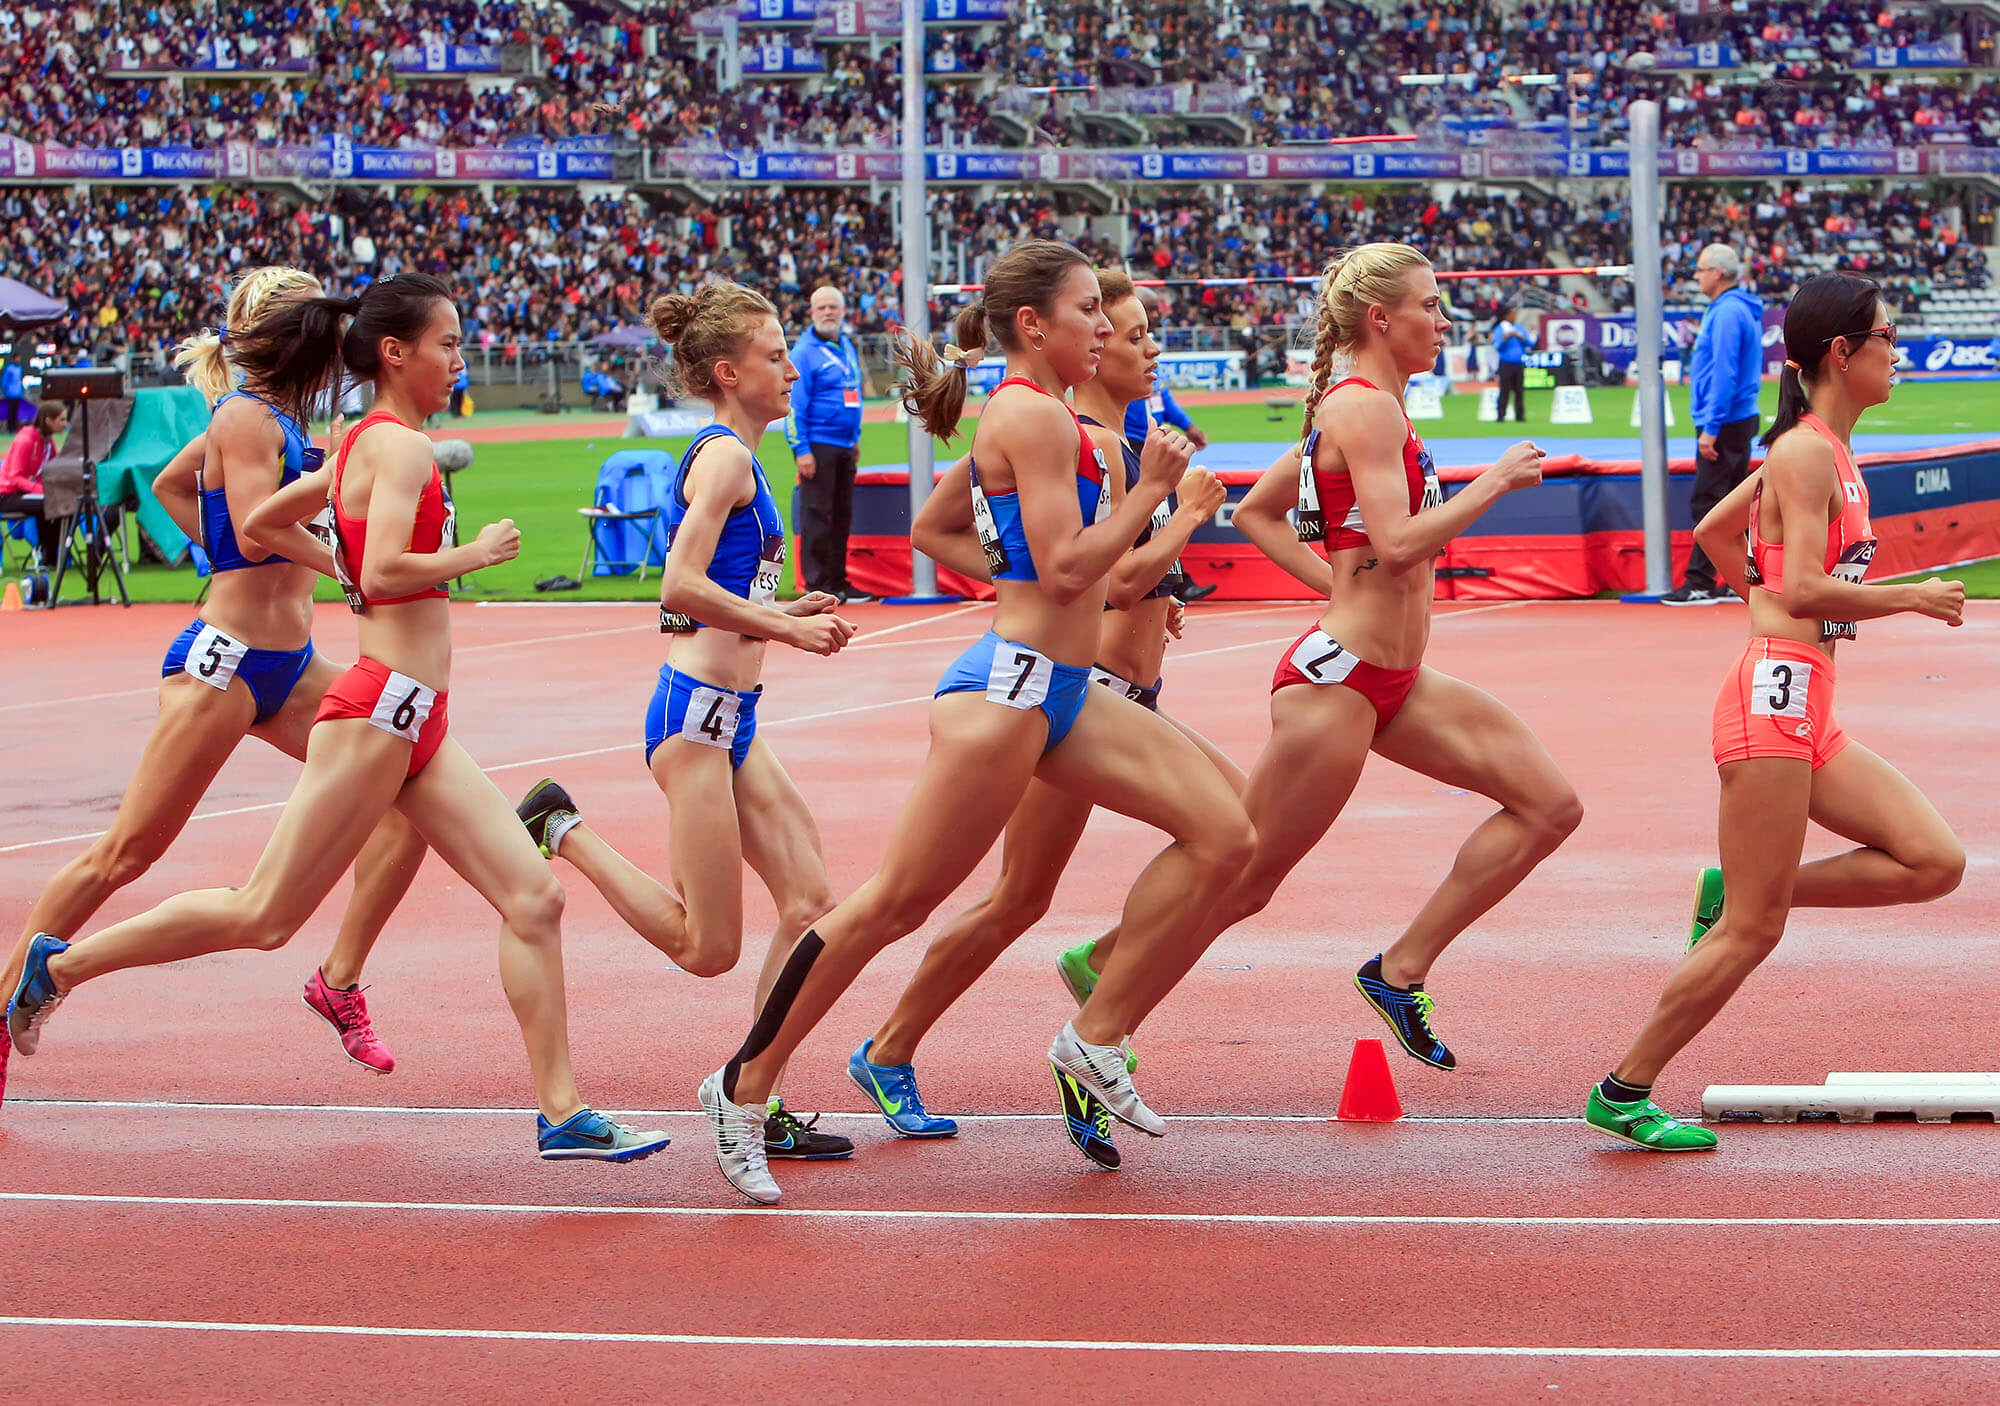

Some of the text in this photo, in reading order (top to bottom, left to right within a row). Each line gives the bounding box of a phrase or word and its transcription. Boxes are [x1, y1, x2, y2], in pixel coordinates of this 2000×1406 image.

[1915, 467, 1951, 495] DIMA
[199, 635, 231, 678] 5
[1007, 652, 1037, 701] 7
[1305, 639, 1344, 679] 2
[391, 686, 421, 731] 6
[1769, 664, 1792, 711] 3
[700, 695, 724, 742] 4
